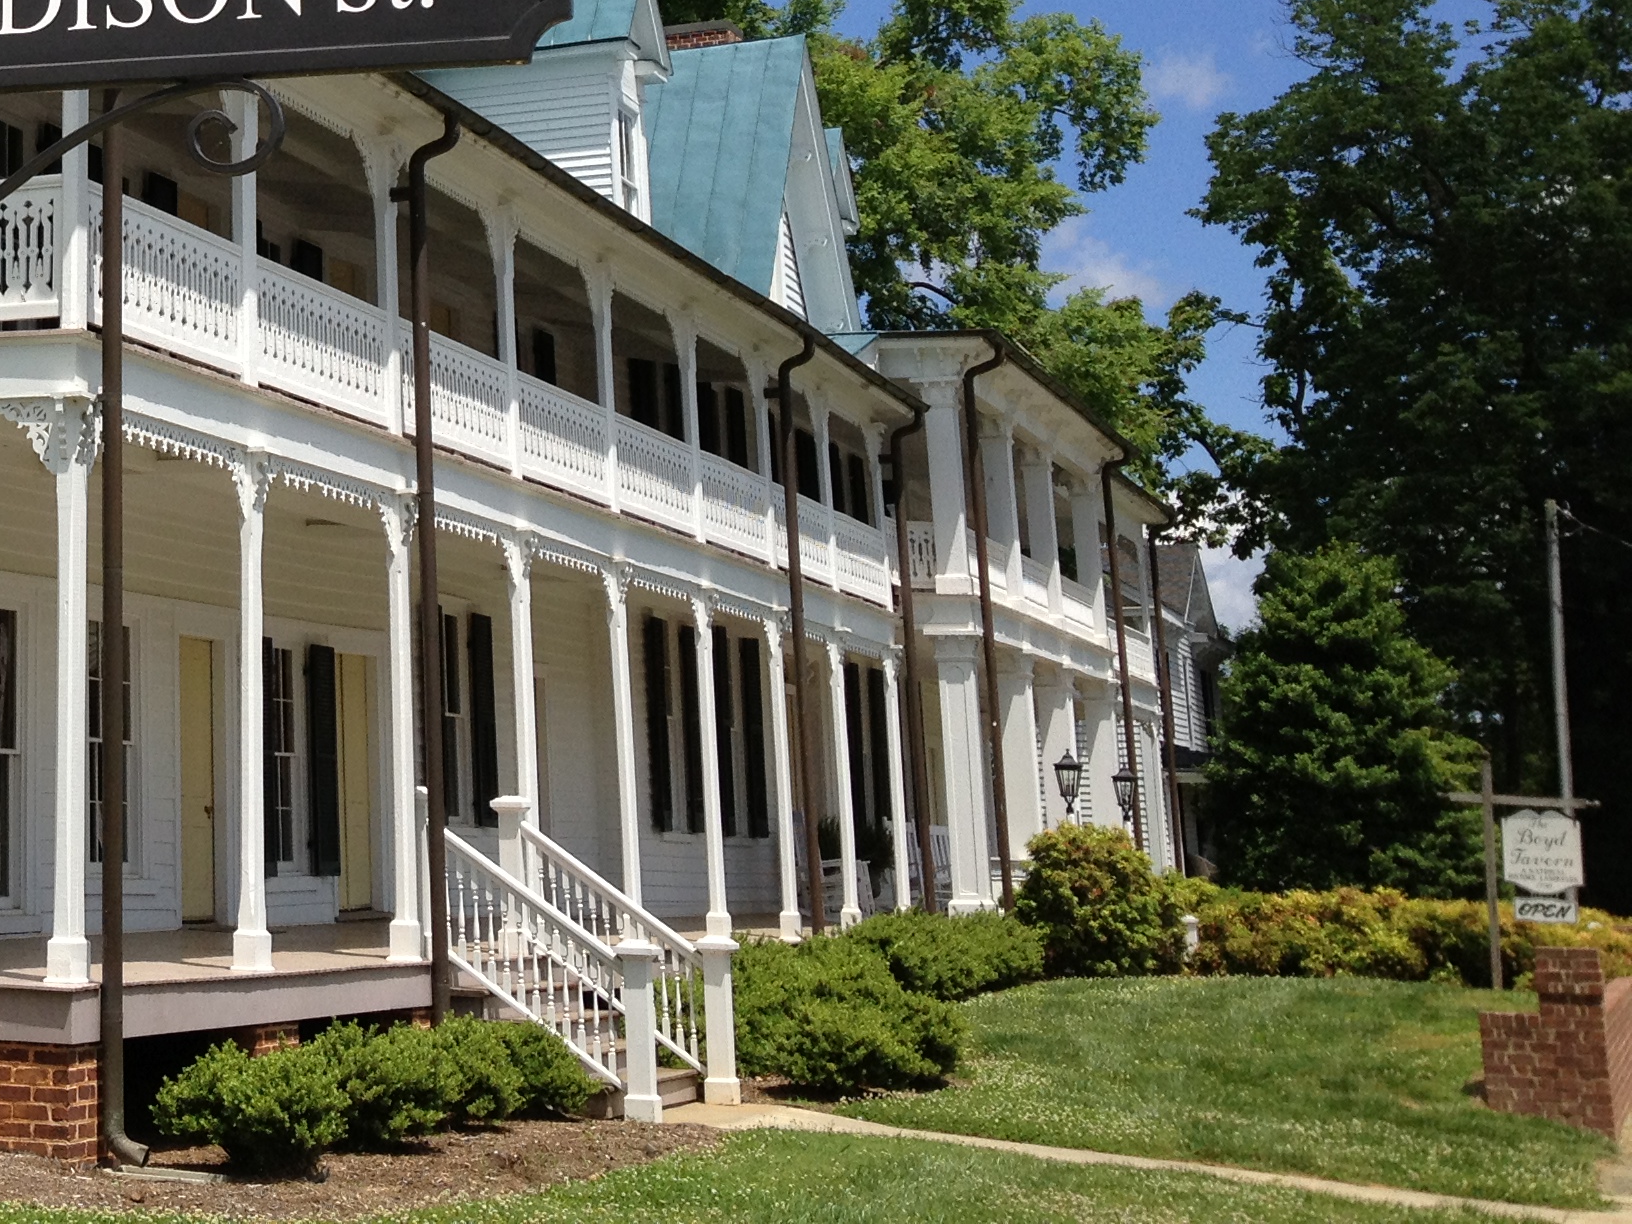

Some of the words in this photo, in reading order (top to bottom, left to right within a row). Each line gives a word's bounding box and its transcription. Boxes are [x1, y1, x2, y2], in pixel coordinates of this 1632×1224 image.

[1518, 828, 1567, 852] Boyd
[1510, 848, 1574, 867] Tavern
[1518, 903, 1572, 919] OPEN
